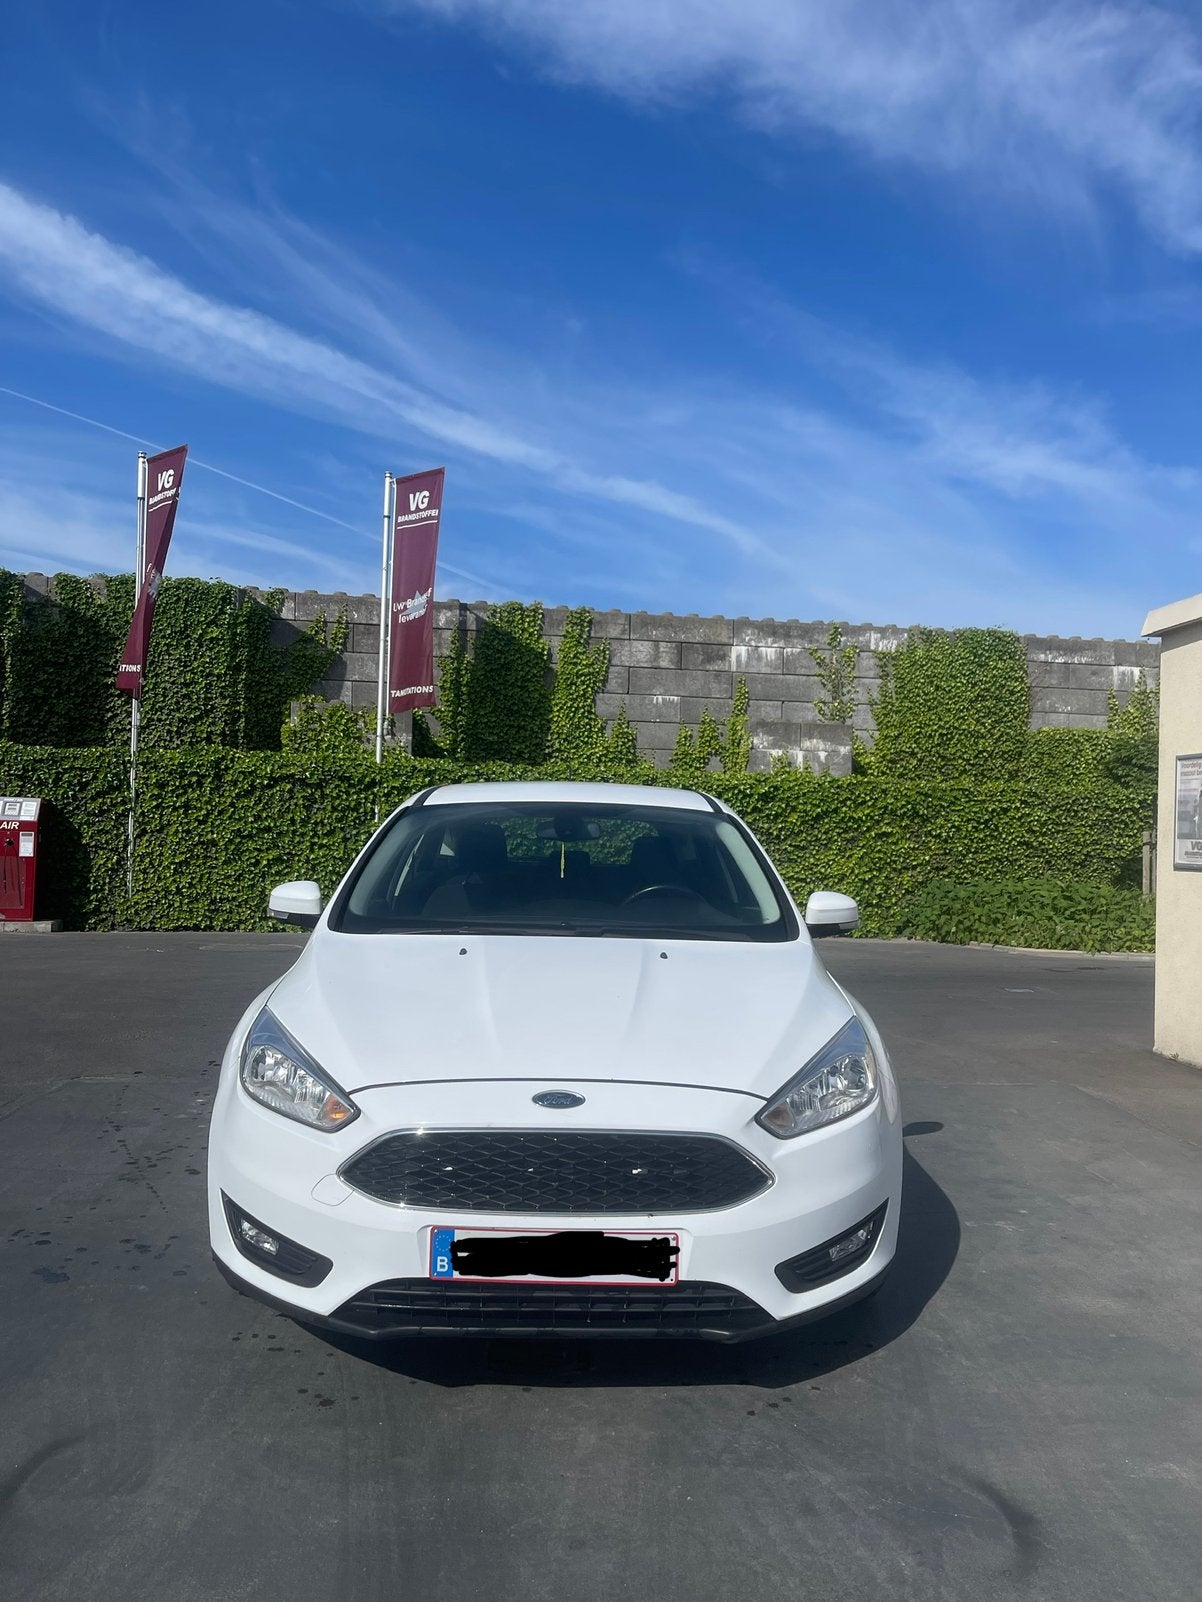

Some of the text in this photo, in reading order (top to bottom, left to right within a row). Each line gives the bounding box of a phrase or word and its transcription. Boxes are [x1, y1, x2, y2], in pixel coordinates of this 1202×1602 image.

[158, 469, 175, 491] VG
[409, 490, 430, 511] VG
[0, 821, 20, 830] AIR
[541, 1093, 576, 1106] Ford
[437, 1256, 448, 1271] B
